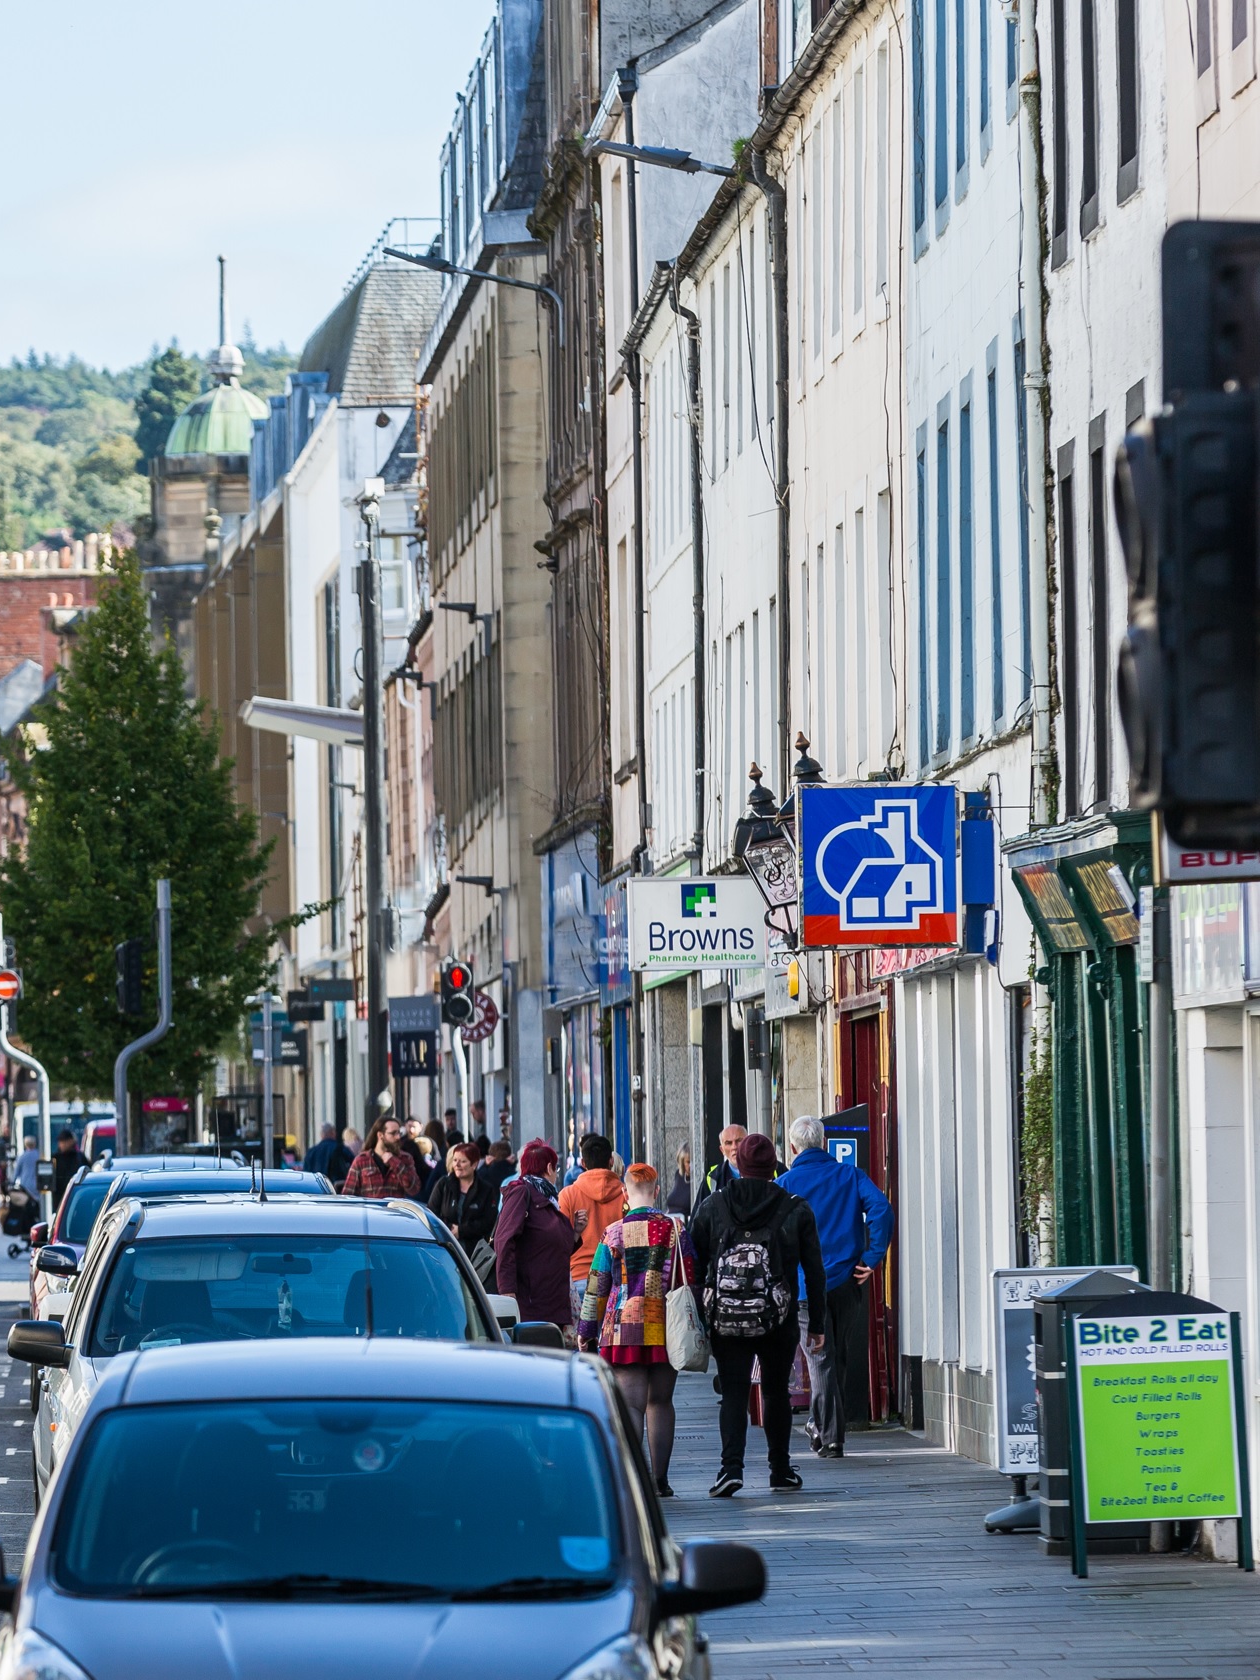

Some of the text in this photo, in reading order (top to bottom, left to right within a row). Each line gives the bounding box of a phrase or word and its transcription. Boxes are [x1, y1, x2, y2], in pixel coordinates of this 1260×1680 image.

[1181, 851, 1260, 867] BUF
[649, 921, 754, 951] Browns
[649, 952, 757, 964] Pharmacy Healthcare
[392, 1008, 431, 1018] OLIVER
[392, 1018, 431, 1028] BONAS
[400, 1039, 428, 1062] GAP
[836, 1144, 852, 1163] P
[1078, 1318, 1228, 1346] Bite 2 Eat
[1080, 1343, 1228, 1357] HOT AND COLD FILLED ROLLS
[1093, 1373, 1219, 1387] Breakfast Rolls all day
[1111, 1392, 1202, 1404] Cold Filled Rolls
[1136, 1411, 1181, 1422] Burgers
[1139, 1429, 1179, 1439] Wraps
[1135, 1447, 1185, 1456] Toasties
[1141, 1464, 1182, 1474] Paninis
[1145, 1482, 1178, 1491] Tea &
[1100, 1493, 1225, 1507] Bite2eat Blend Coffee
